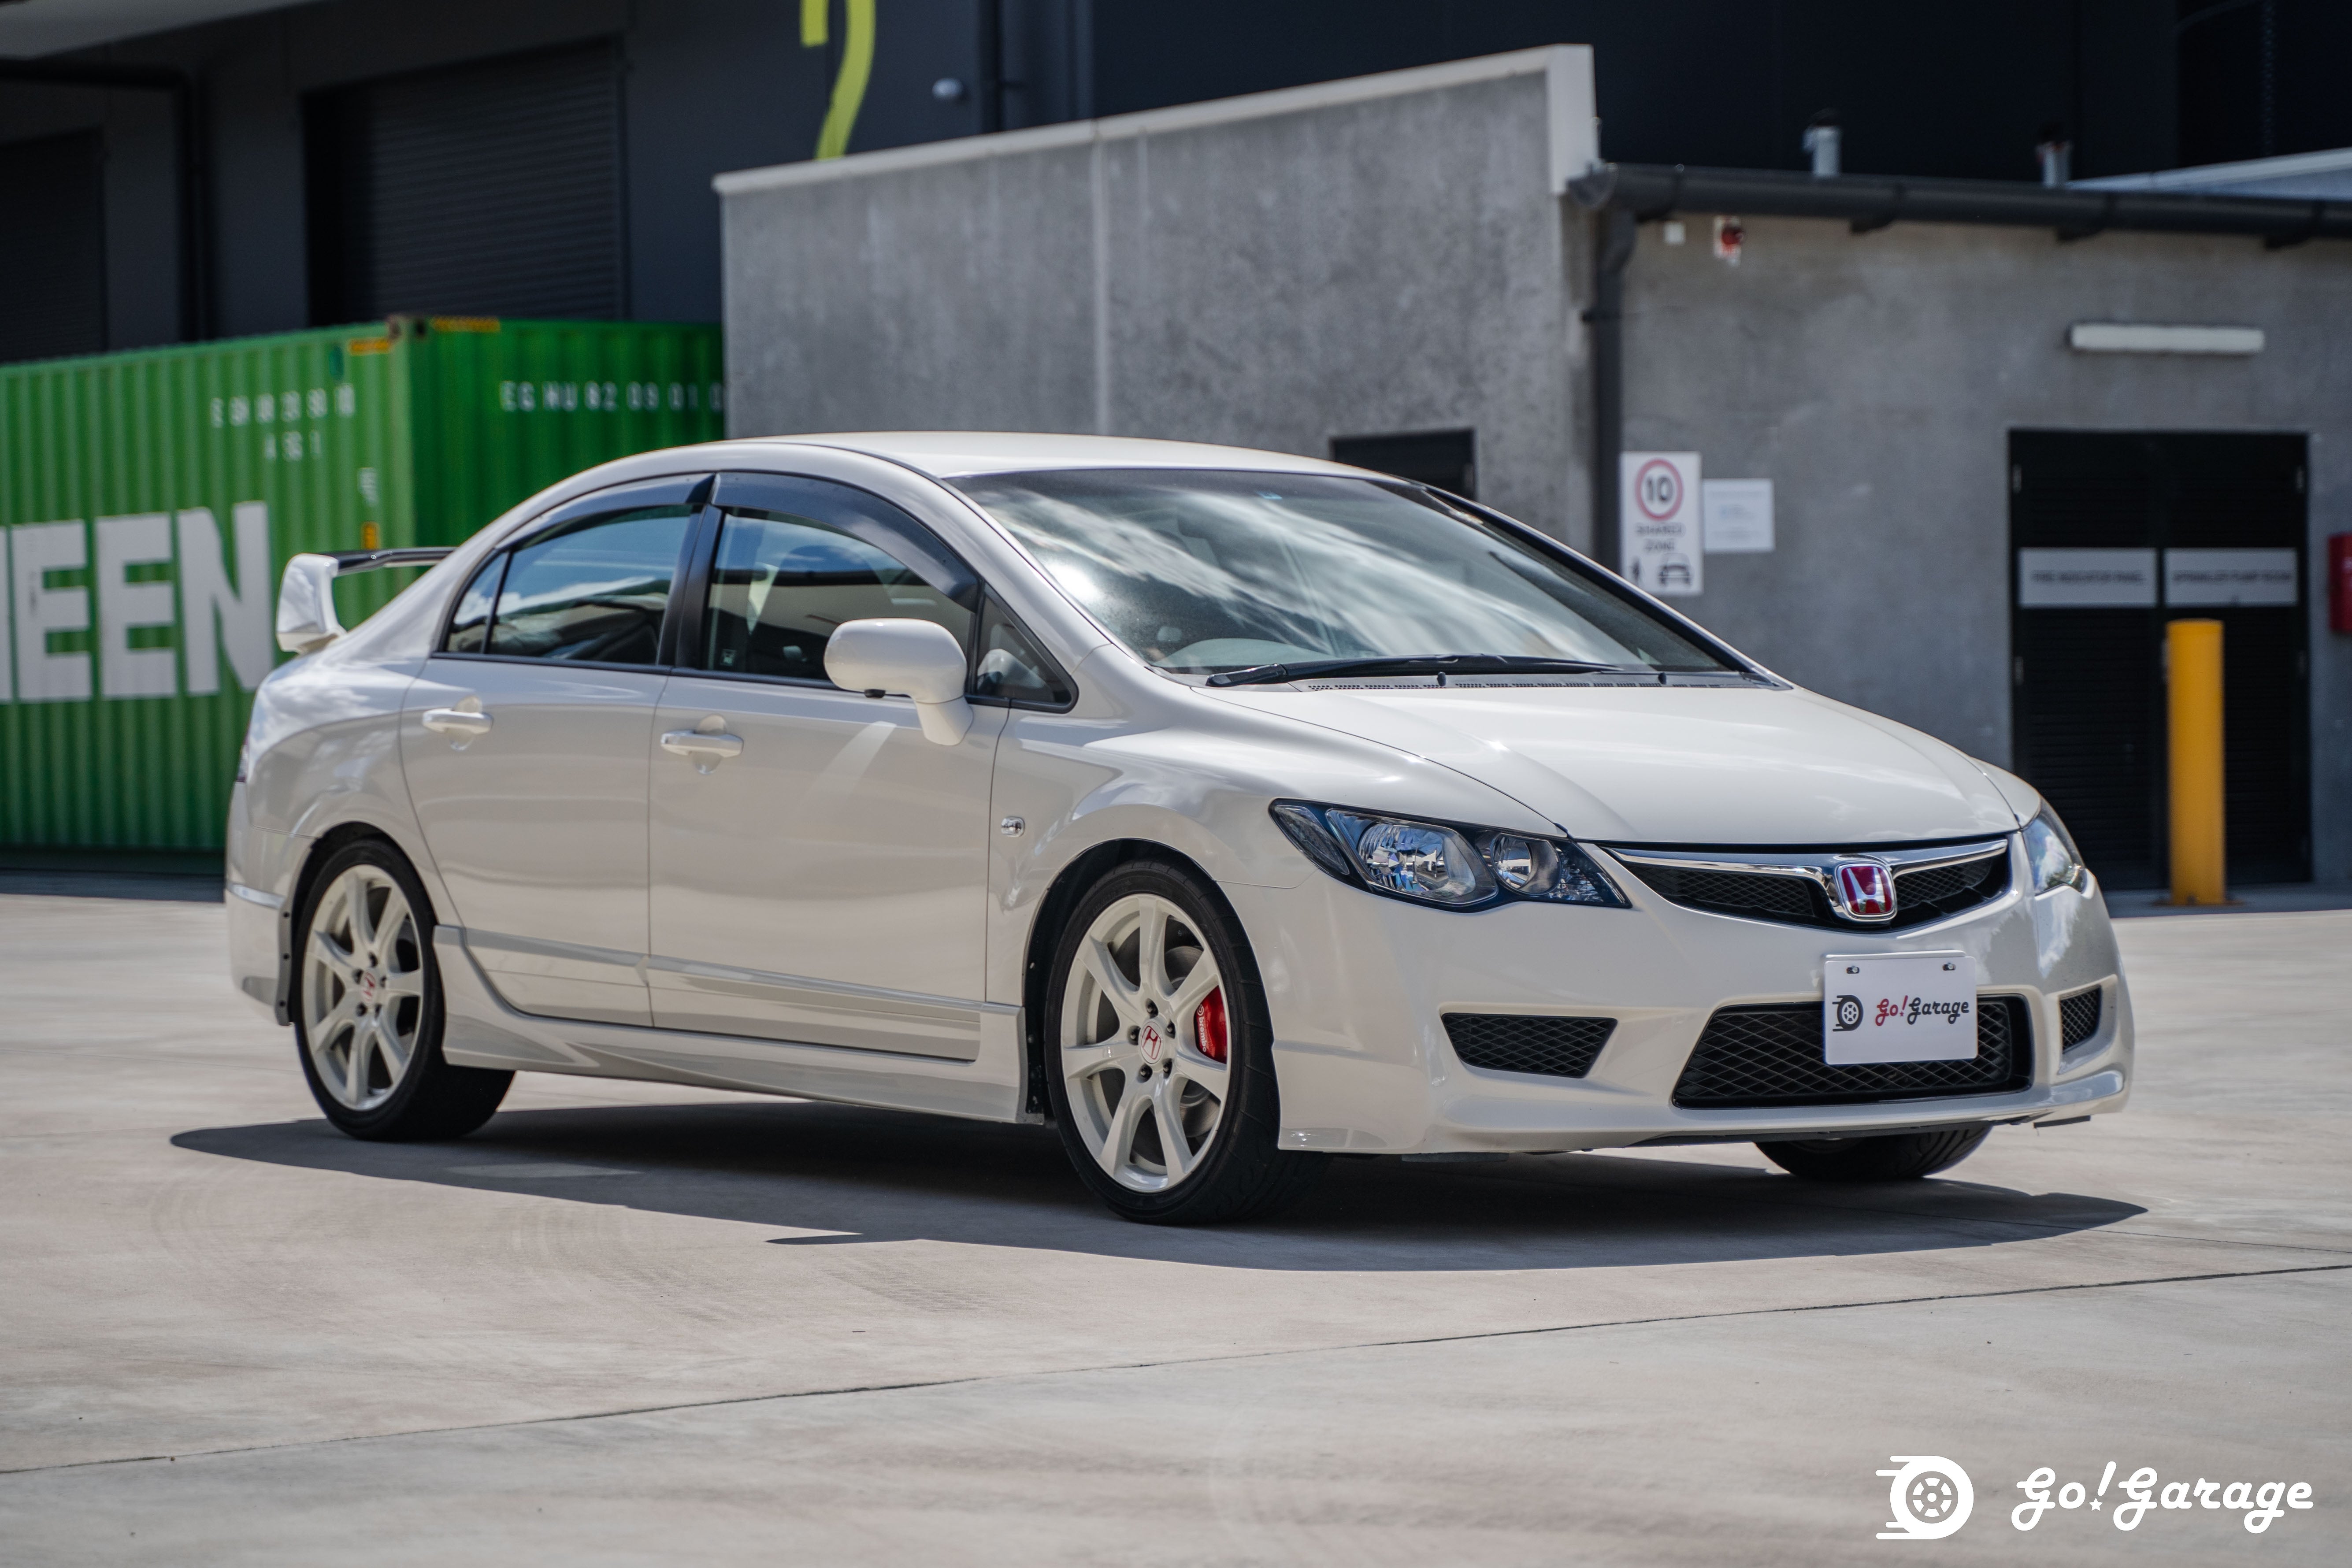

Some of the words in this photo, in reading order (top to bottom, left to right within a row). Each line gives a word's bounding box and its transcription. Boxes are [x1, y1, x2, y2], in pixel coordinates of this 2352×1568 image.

[1646, 474, 1673, 503] 10
[0, 500, 275, 703] EEN
[1198, 1016, 1207, 1053] brembo
